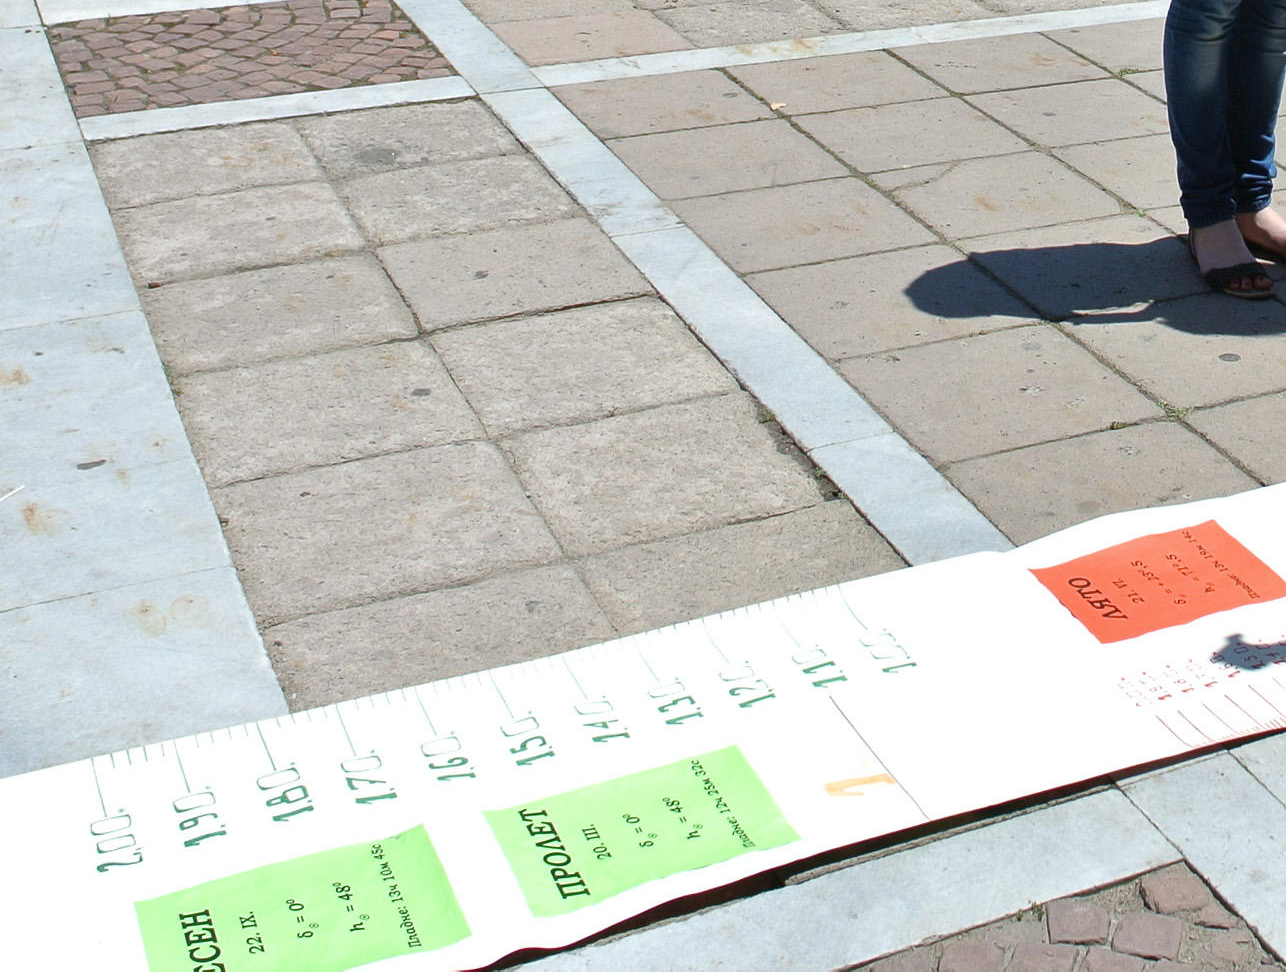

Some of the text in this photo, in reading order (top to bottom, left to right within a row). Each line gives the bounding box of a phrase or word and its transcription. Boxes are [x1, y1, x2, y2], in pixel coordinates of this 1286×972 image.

[1068, 577, 1129, 620] ЛЯТО
[517, 809, 591, 899] ПРОЛЕТ
[592, 842, 612, 860] 20.
[239, 911, 265, 954] 22. IX.
[398, 905, 422, 948] Пладне:
